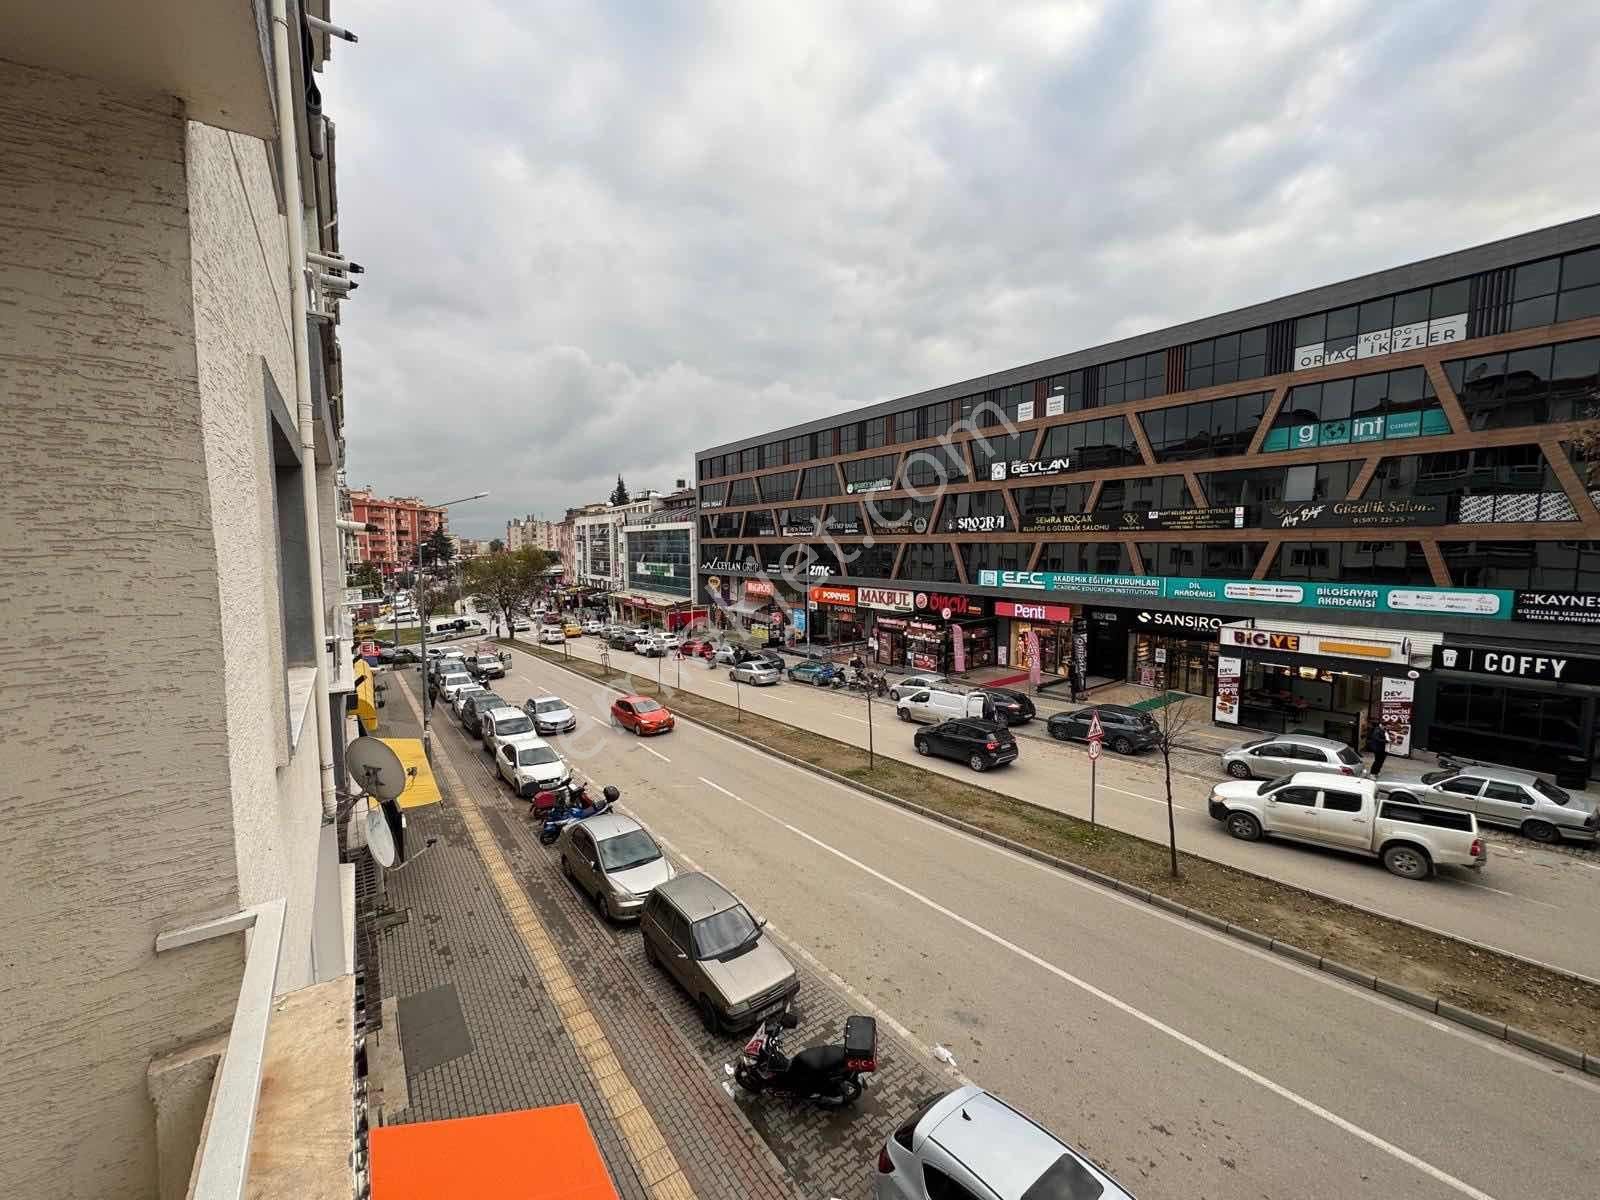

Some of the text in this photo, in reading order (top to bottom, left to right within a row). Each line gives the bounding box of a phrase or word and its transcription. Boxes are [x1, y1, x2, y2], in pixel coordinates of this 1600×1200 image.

[1089, 575, 1112, 585] EĞİTİM
[1114, 577, 1160, 587] KURUMLARI
[1115, 588, 1158, 596] INSTITUTIONS
[1317, 587, 1378, 599] BİLGİSAYAR
[861, 590, 911, 607] MAKBUL
[1318, 597, 1377, 608] AKADEMİSİ
[1014, 604, 1046, 620] Penti
[1484, 653, 1567, 679] COFFY
